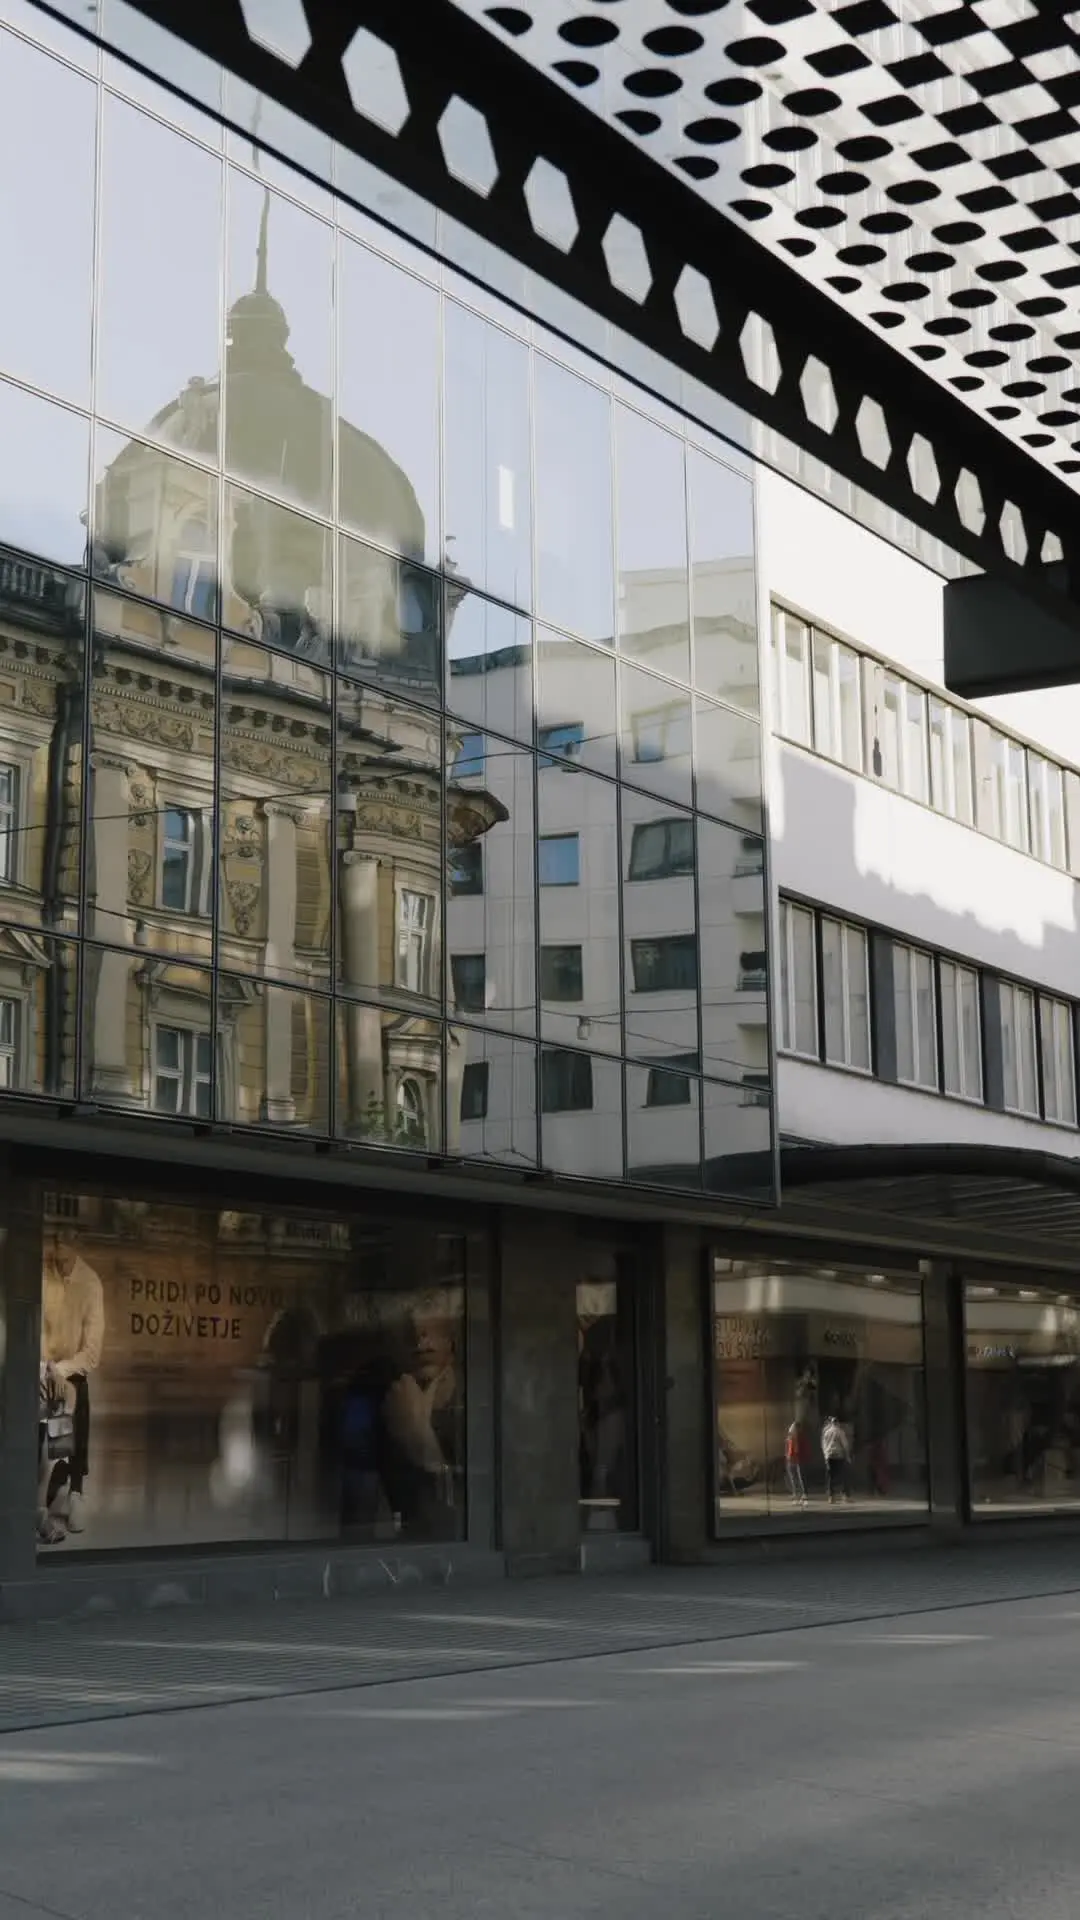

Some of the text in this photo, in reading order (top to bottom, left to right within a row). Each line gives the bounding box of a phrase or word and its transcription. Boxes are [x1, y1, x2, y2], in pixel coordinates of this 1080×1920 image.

[131, 1279, 187, 1303] PRIDI
[195, 1282, 221, 1305] PO
[131, 1309, 242, 1339] DOŽIVETJE
